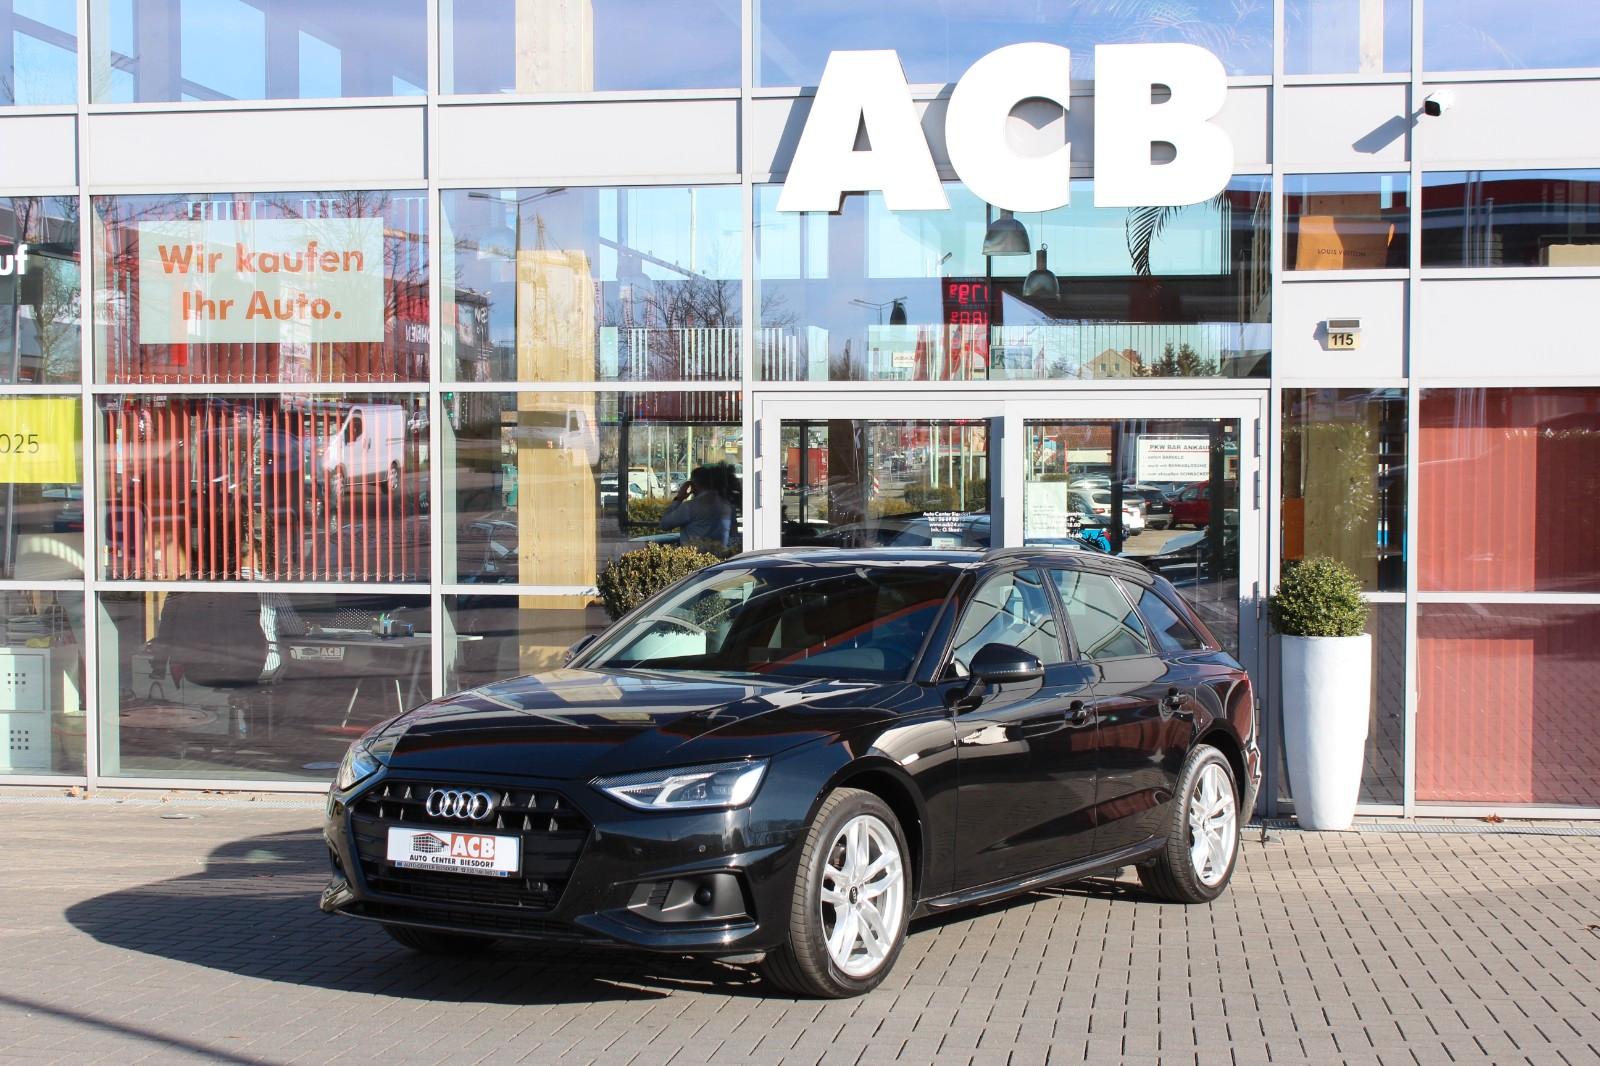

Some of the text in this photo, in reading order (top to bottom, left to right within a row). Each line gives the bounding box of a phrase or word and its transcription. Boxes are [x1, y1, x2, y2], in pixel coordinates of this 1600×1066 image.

[775, 42, 1235, 213] ACB
[158, 240, 364, 274] Wir kaufen
[182, 290, 342, 321] Ihr Auto.
[1331, 333, 1354, 346] 115
[320, 647, 341, 656] ACB
[451, 835, 495, 858] ACB
[409, 854, 495, 868] AUTO CENTER BIESDORF
